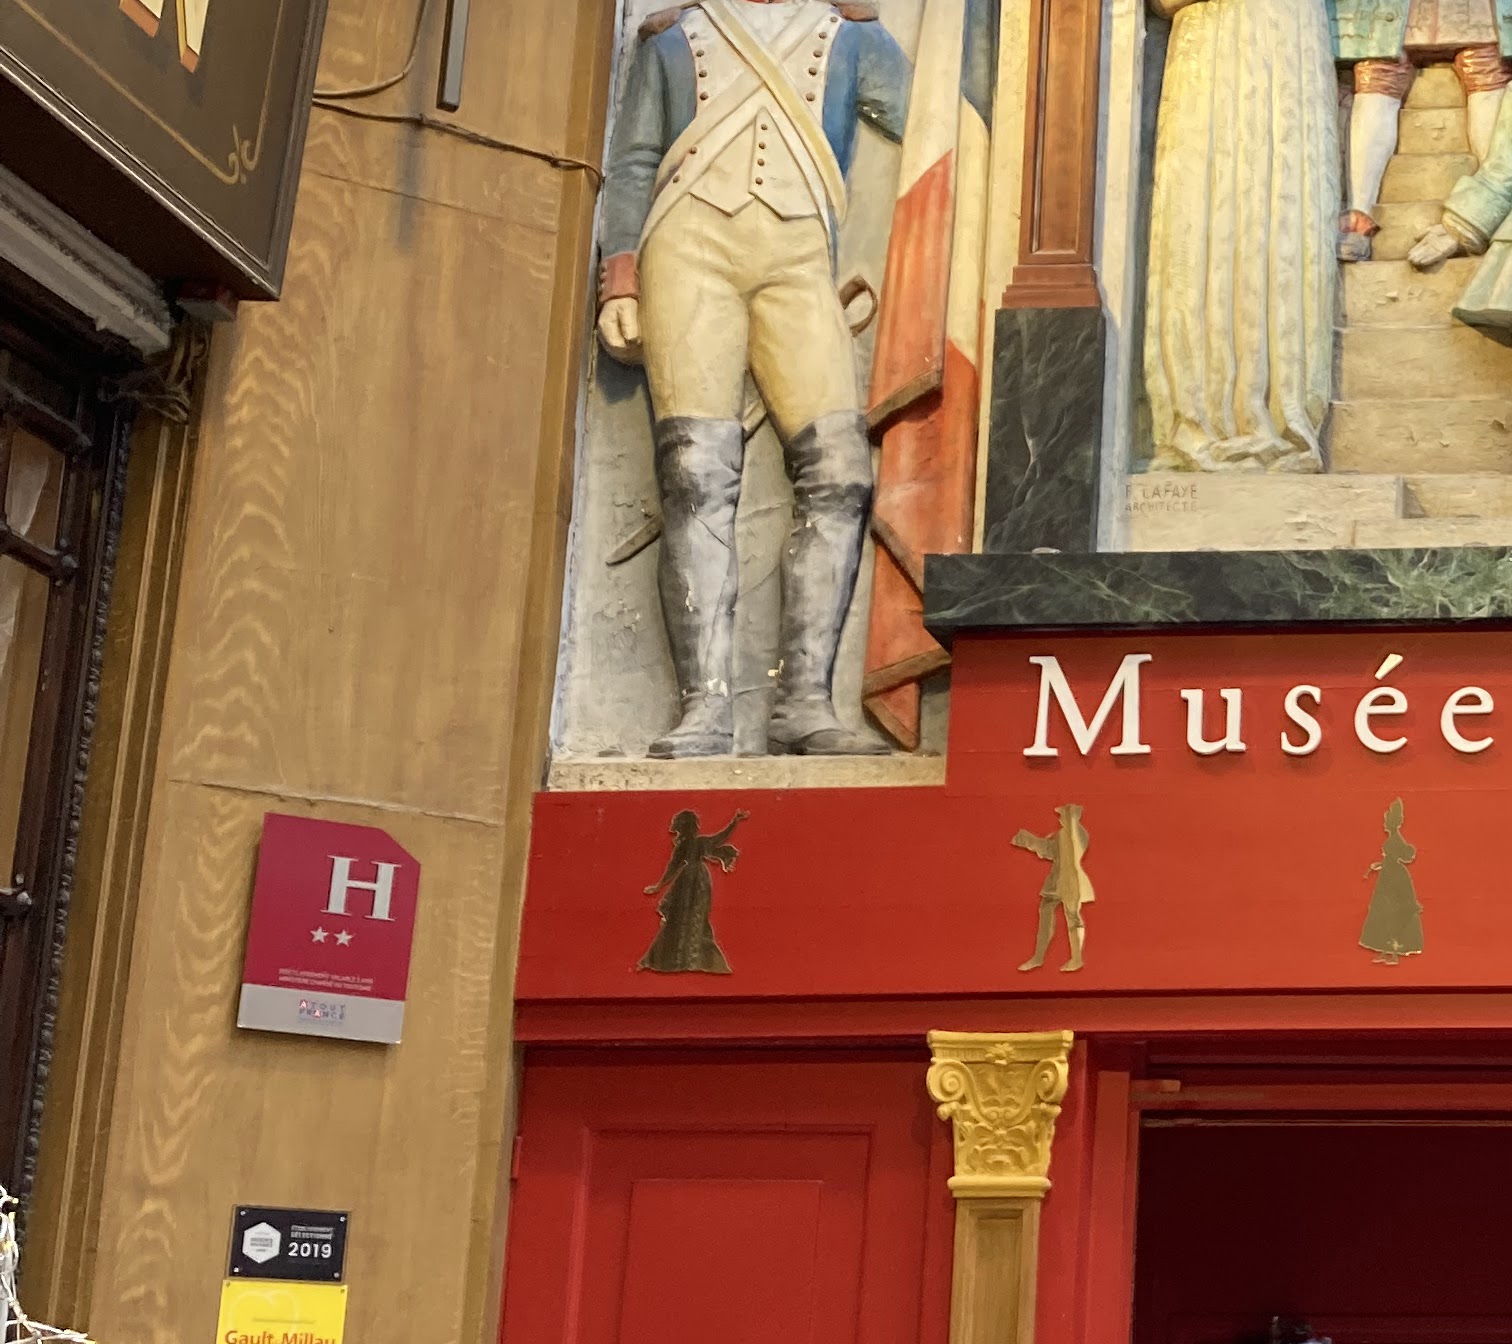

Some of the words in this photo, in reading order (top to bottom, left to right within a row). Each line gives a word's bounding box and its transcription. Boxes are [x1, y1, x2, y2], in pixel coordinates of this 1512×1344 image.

[1142, 483, 1198, 499] LAFAYE
[1125, 501, 1197, 513] ARCHITECTE
[1023, 653, 1494, 756] Musée
[320, 855, 402, 922] H
[288, 1242, 332, 1258] 2019
